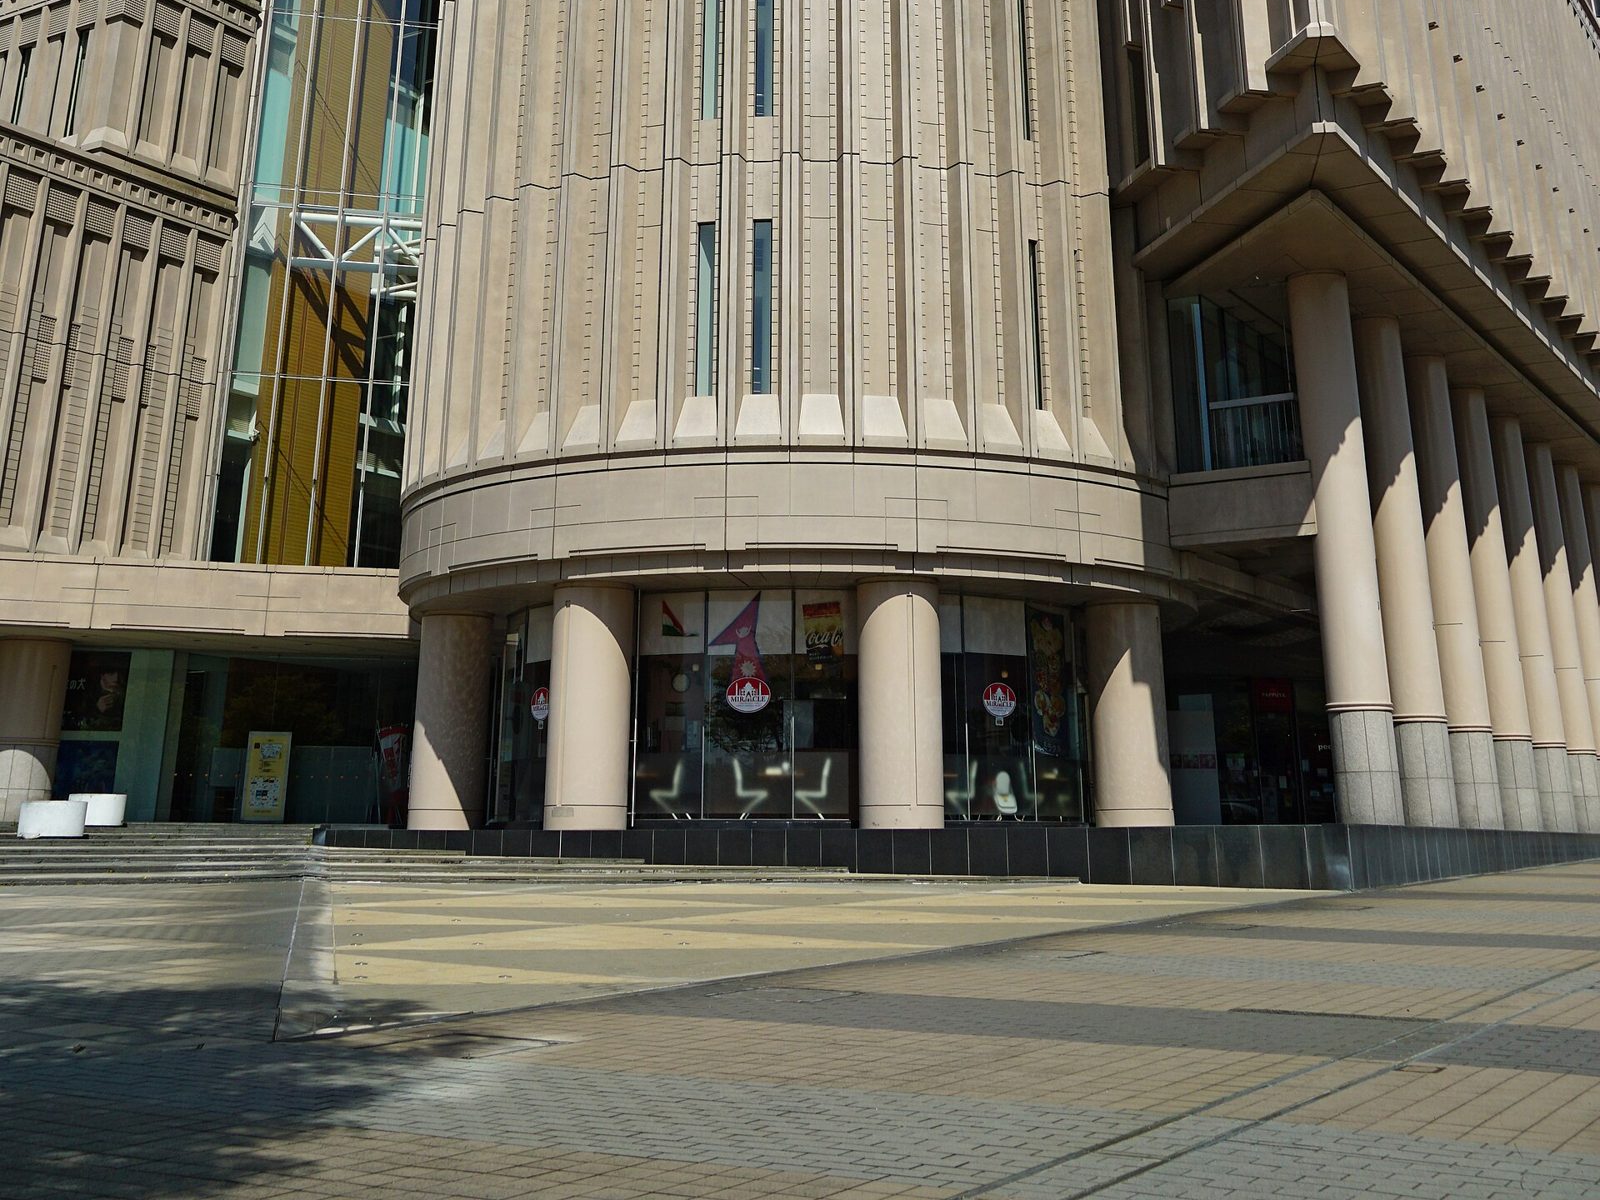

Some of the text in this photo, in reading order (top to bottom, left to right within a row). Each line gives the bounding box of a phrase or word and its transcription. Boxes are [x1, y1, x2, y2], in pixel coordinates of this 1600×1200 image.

[65, 677, 86, 690] の犬
[731, 694, 766, 703] MIRACLE
[986, 699, 1013, 708] MIRACLE
